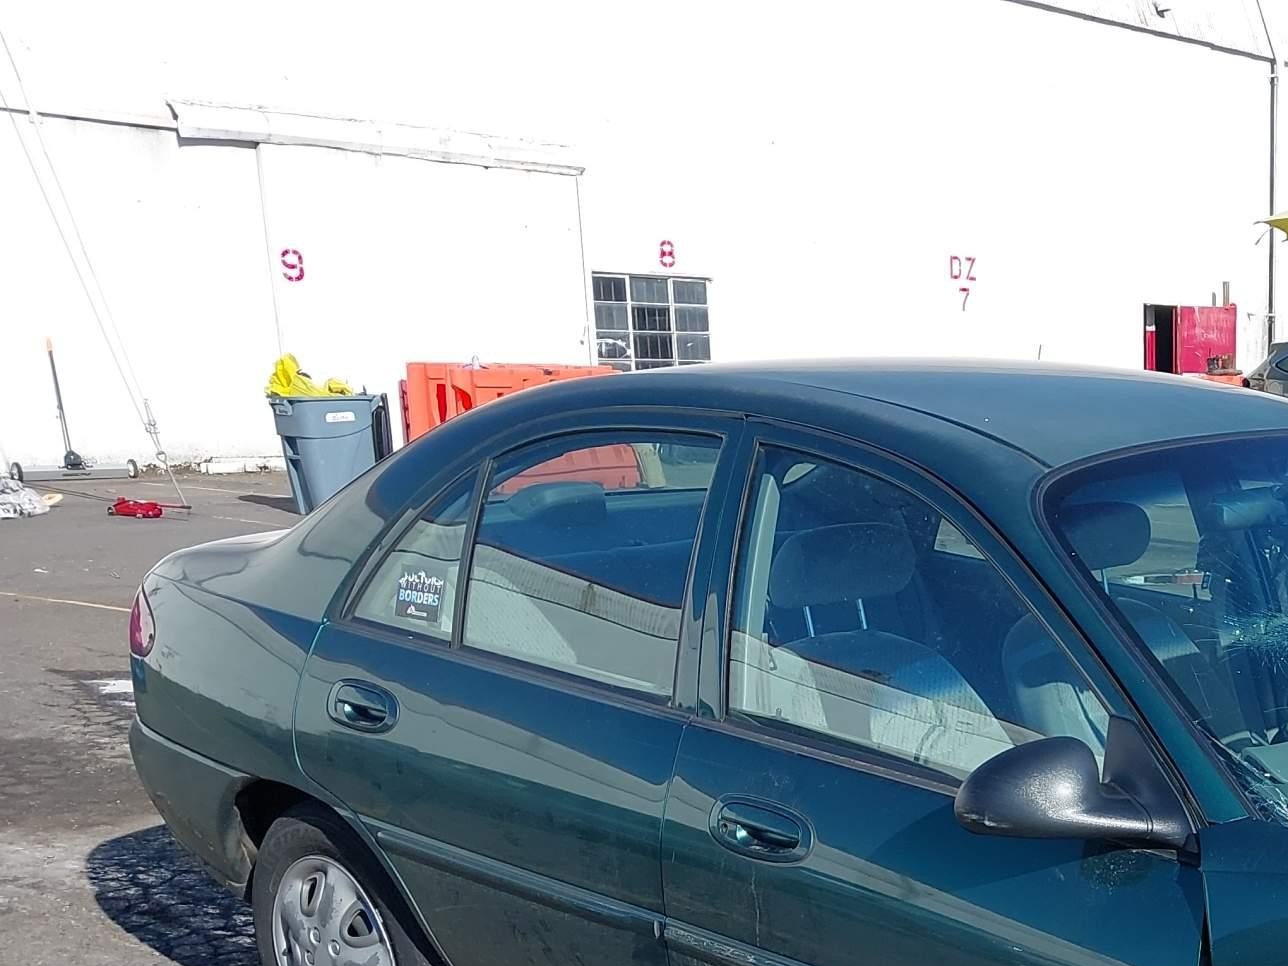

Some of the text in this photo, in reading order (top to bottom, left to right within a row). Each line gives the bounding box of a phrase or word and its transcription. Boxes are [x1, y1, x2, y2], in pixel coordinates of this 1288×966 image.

[280, 248, 305, 283] 9
[658, 239, 676, 269] 8
[949, 255, 977, 282] DZ
[958, 287, 970, 312] 7
[398, 588, 440, 606] BORDERS
[400, 581, 441, 594] WITHOUT
